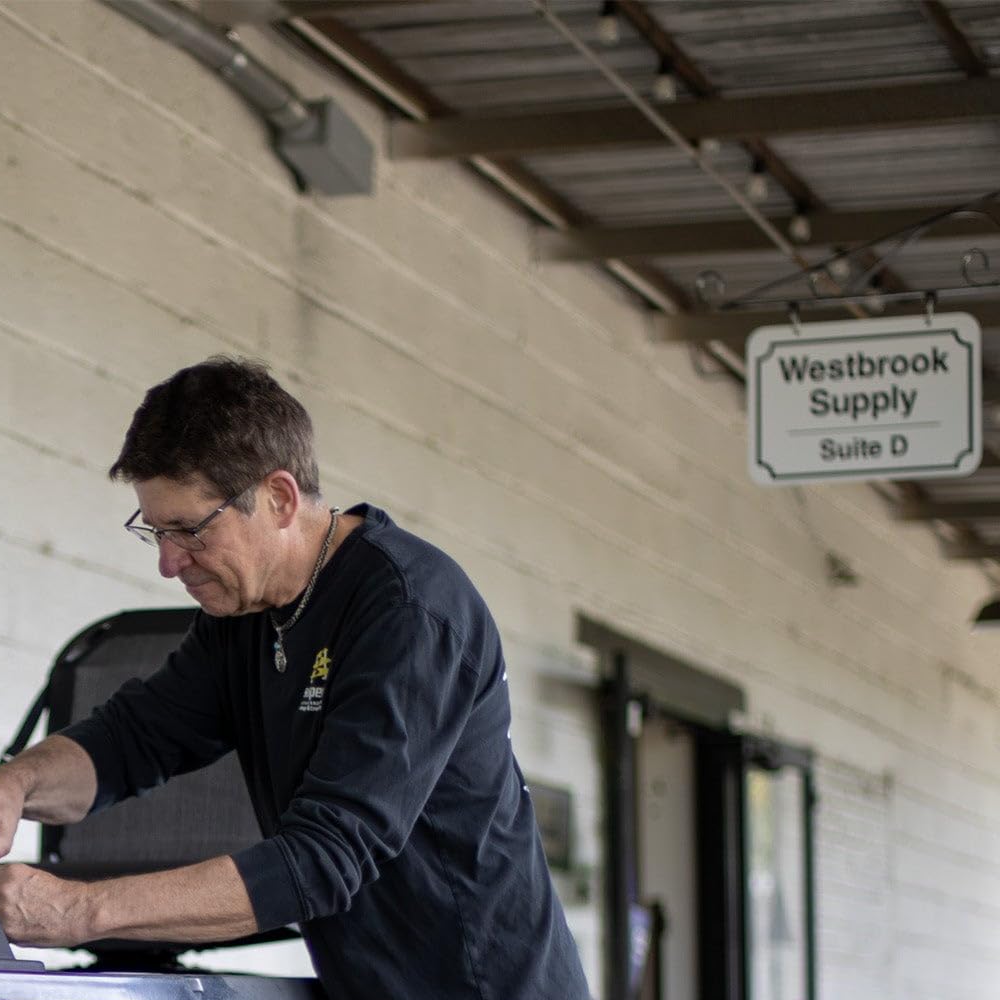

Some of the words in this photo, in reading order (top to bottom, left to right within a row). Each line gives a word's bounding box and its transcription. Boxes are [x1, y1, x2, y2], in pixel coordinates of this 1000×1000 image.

[778, 346, 949, 384] Westbrook
[809, 384, 918, 420] Supply
[819, 437, 883, 461] Suite
[890, 434, 909, 456] D
